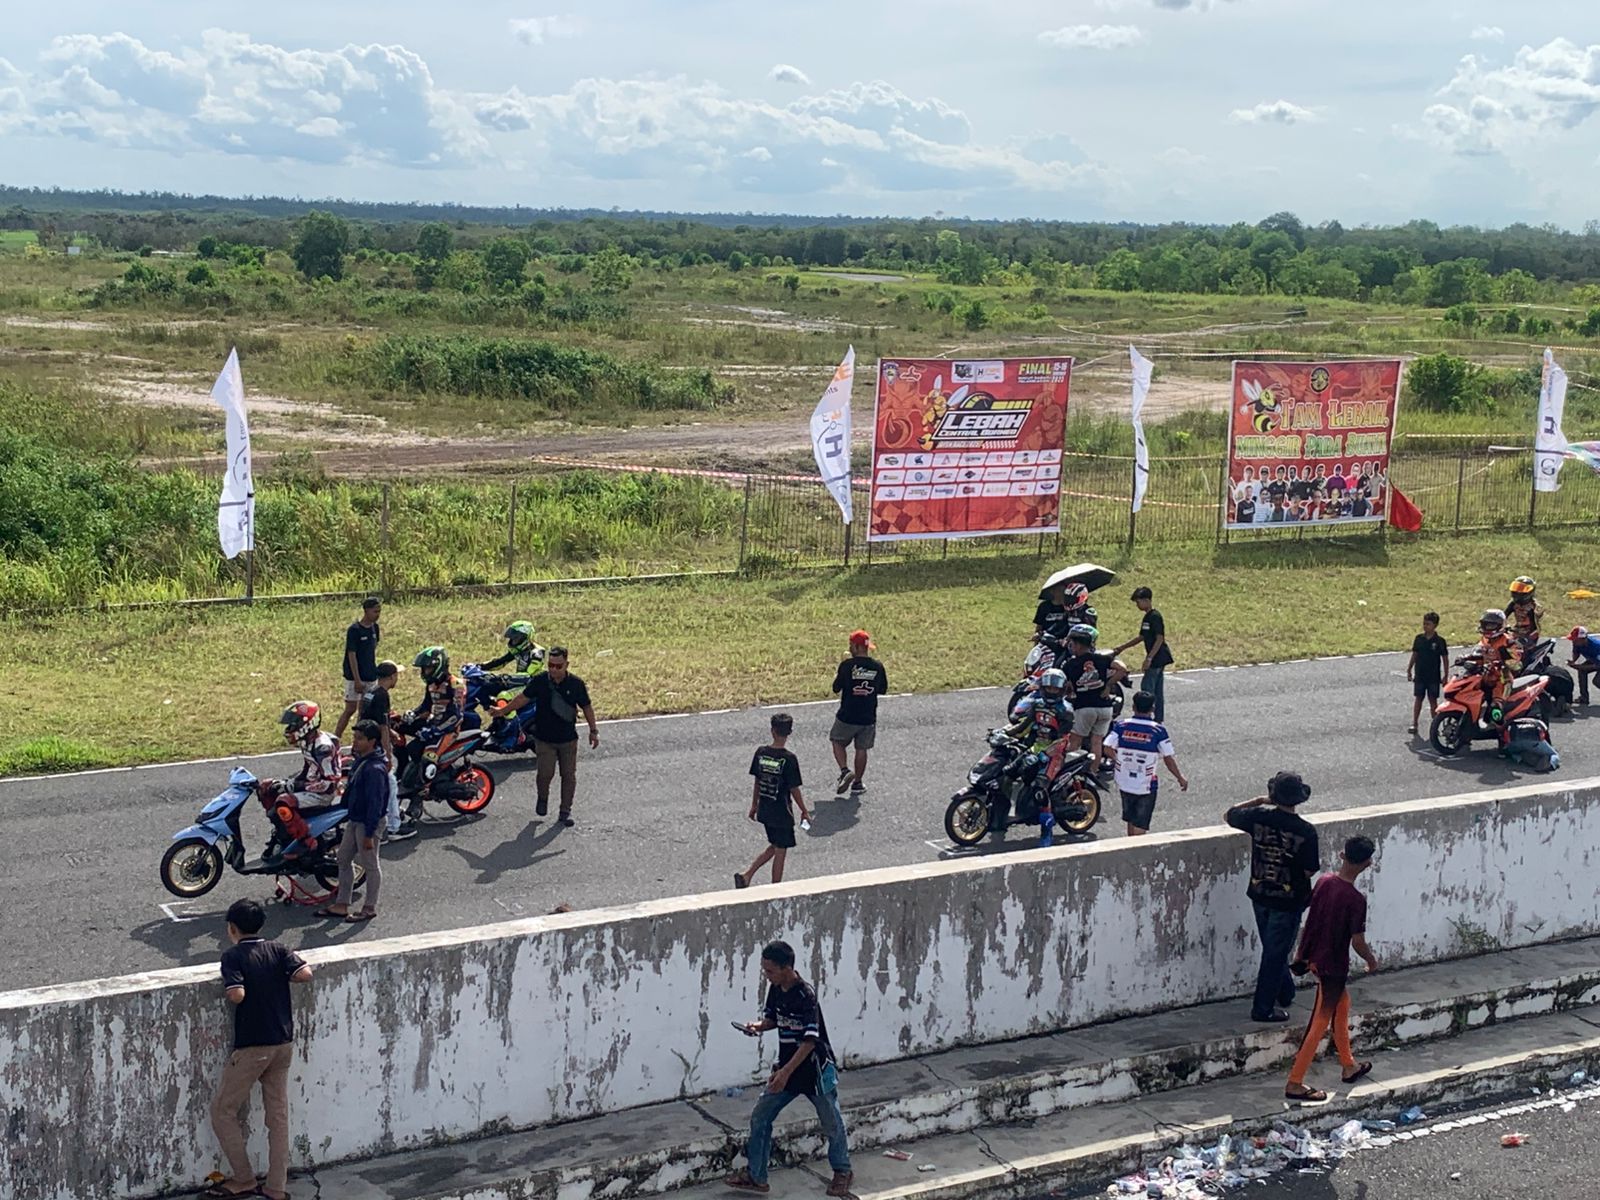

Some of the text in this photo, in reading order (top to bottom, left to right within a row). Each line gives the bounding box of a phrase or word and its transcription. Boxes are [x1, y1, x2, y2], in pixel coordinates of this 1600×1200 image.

[1018, 363, 1051, 375] FINAL
[942, 414, 1025, 430] LEBAH
[1234, 435, 1302, 459] MINGGIR
